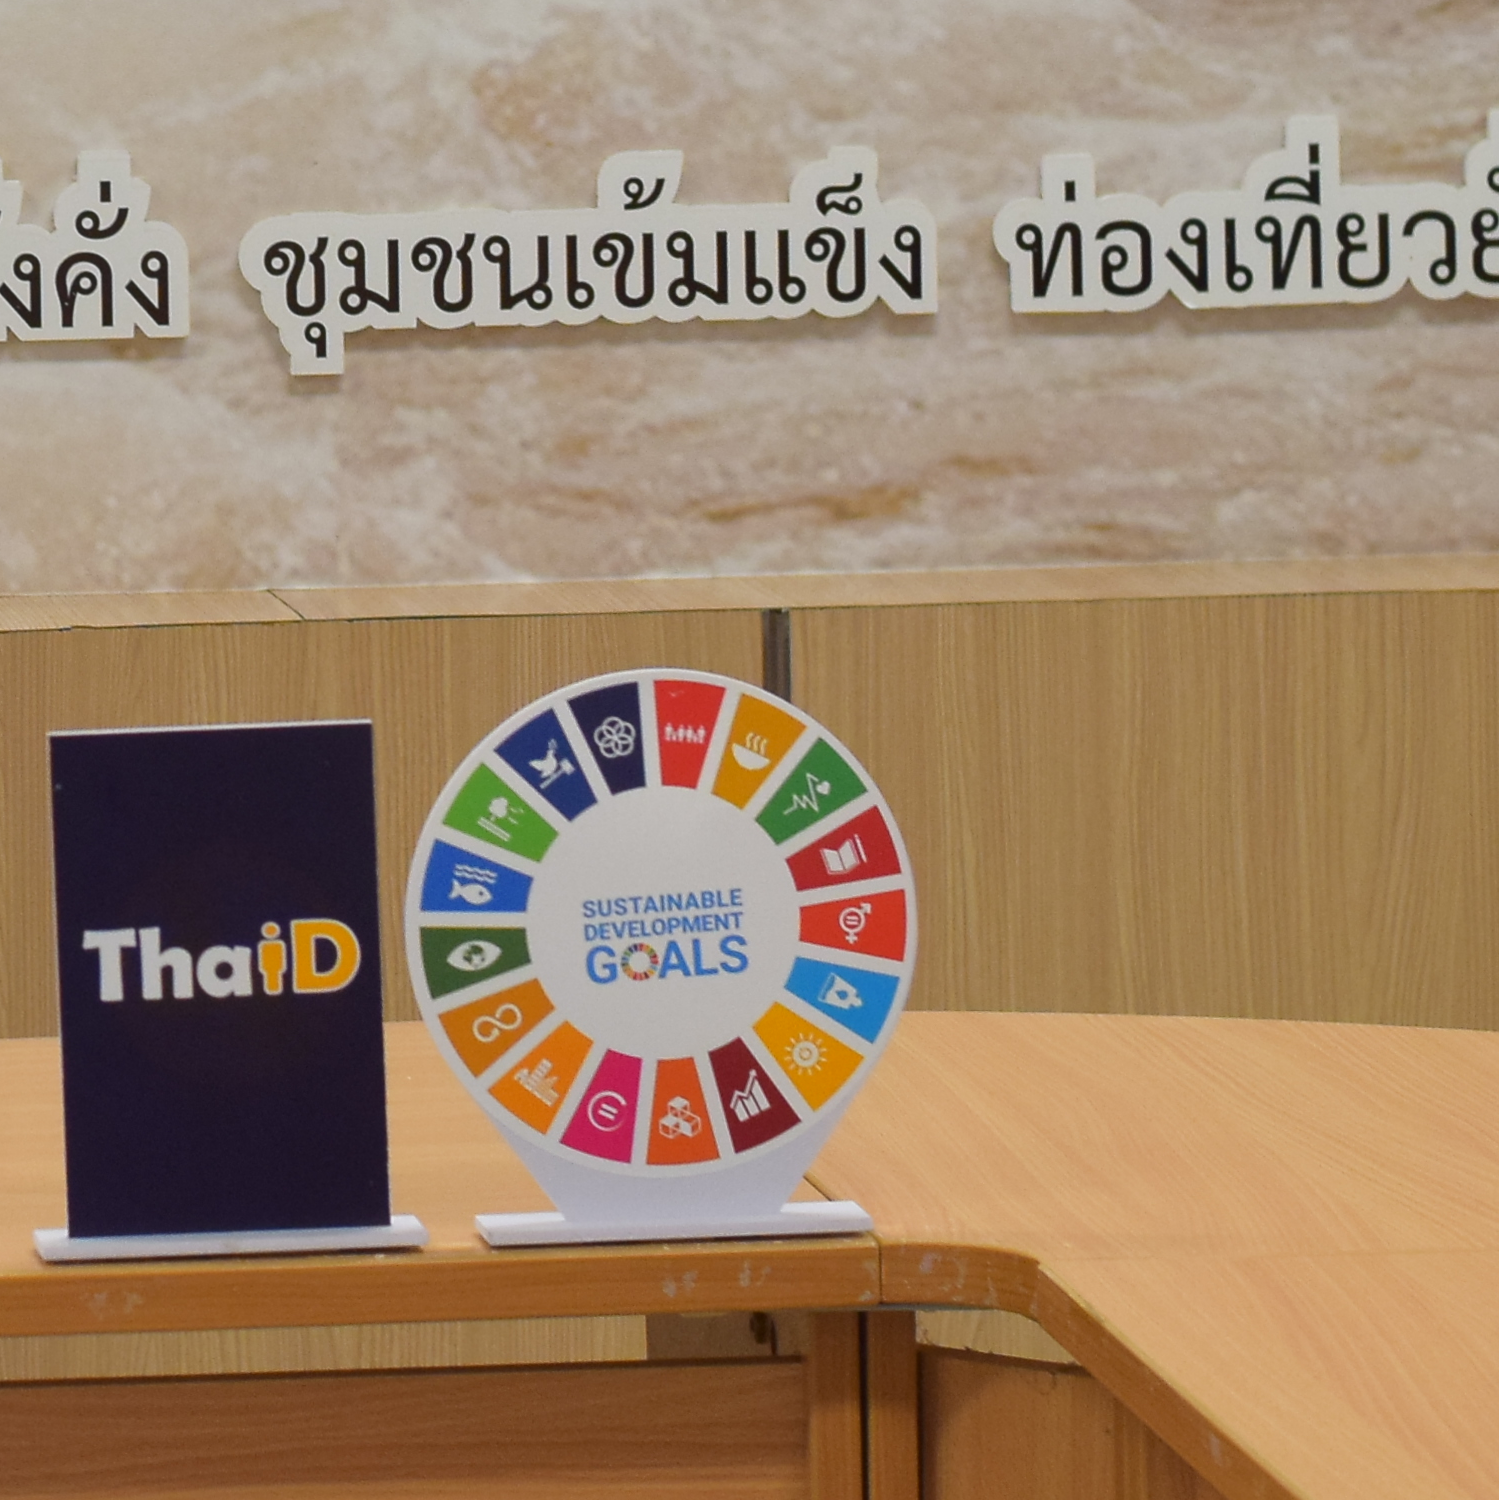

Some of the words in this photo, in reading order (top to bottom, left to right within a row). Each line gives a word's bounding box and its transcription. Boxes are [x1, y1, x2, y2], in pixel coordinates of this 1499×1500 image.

[264, 173, 922, 358] ชุมชนเข้มแข็ง
[582, 888, 743, 918] SUSTAINABLE
[583, 911, 744, 941] DEVELOPMENT
[82, 919, 361, 1001] ThaiD
[586, 934, 749, 984] GOALS
